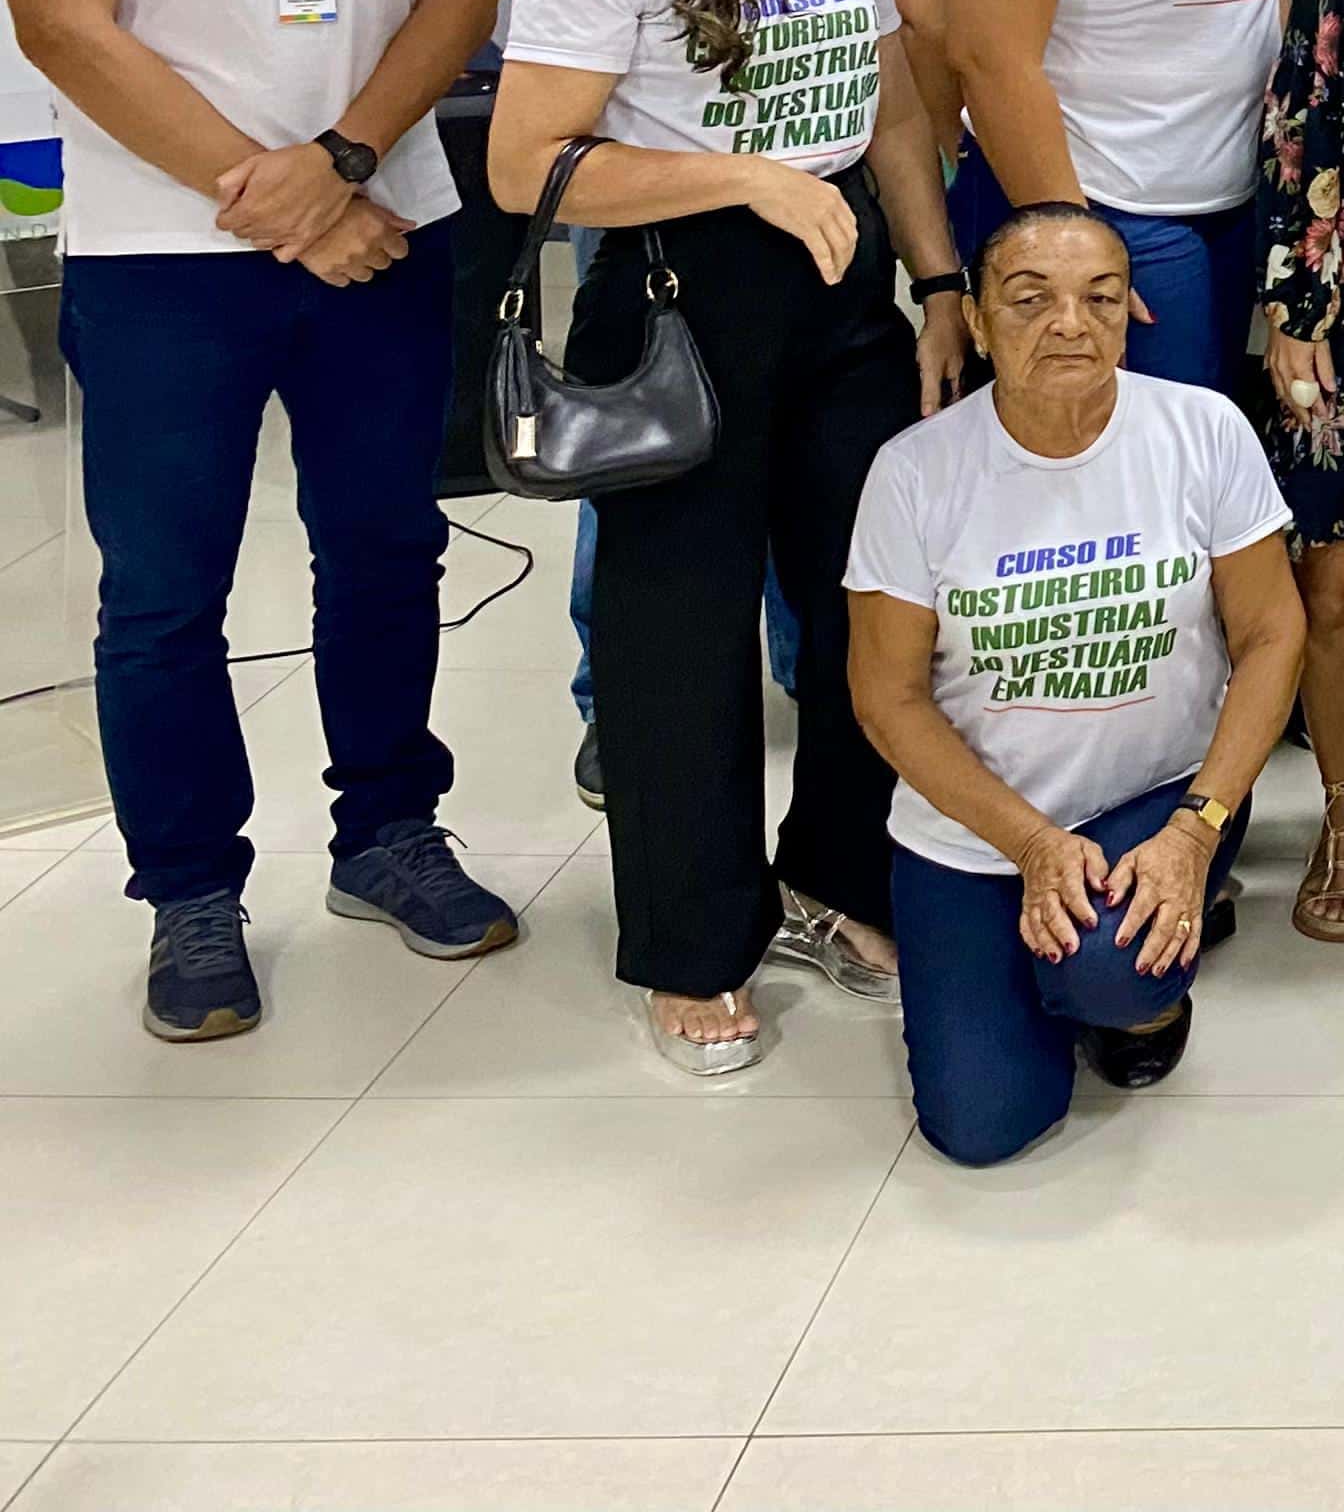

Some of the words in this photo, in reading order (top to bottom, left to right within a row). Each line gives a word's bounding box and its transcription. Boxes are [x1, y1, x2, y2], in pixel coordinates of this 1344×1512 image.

[720, 39, 878, 94] NDUSTRIAL
[701, 99, 747, 128] DO
[782, 106, 866, 148] MALHA
[995, 540, 1097, 578] CURSO
[1105, 532, 1142, 560] DE
[947, 563, 1146, 618] COSTUREIRO
[970, 597, 1169, 652] INDUSTRIAL
[1010, 626, 1177, 679] VESTUÁRIO
[990, 676, 1035, 702] EM
[1042, 663, 1149, 700] MALHA
